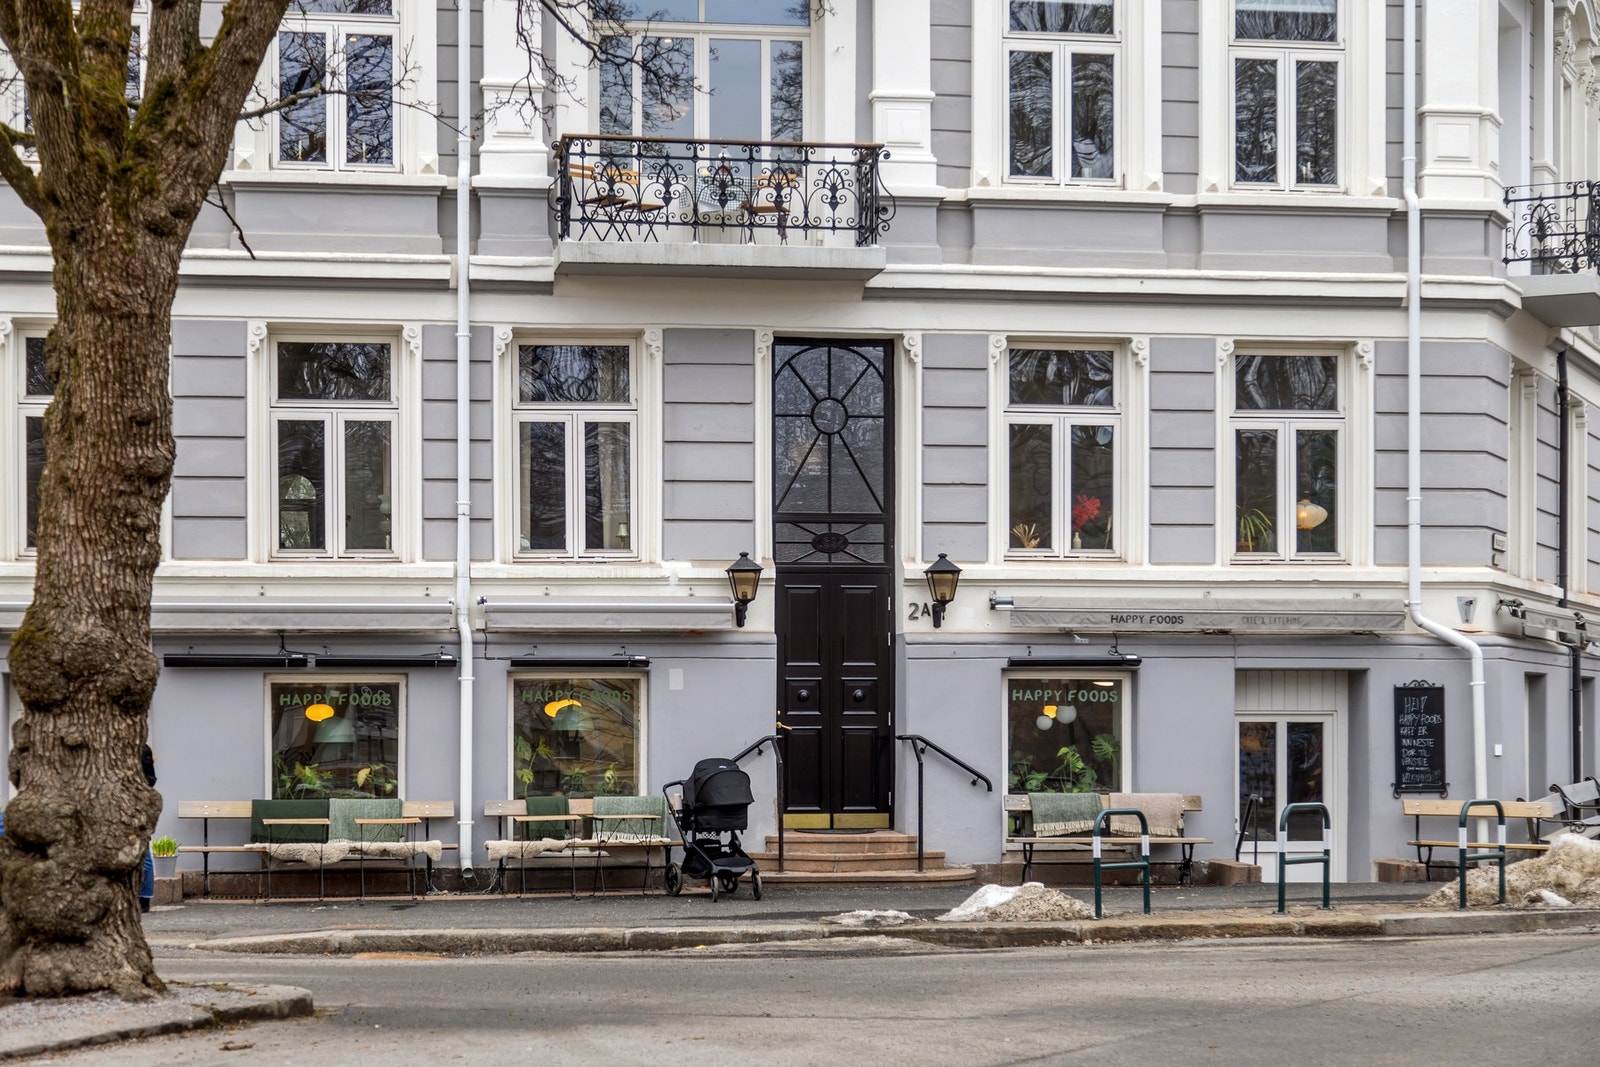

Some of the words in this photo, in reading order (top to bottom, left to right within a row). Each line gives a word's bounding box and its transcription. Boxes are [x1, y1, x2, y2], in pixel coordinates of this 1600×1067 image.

[908, 602, 931, 621] 2A
[1110, 614, 1145, 624] HAPPY
[1149, 615, 1184, 625] FOODS
[279, 693, 332, 706] HAPPY
[338, 693, 391, 706] FOODS
[522, 689, 574, 702] HAPPY
[580, 690, 631, 702] FOODS
[1012, 689, 1062, 702] HAPPY
[1068, 690, 1118, 703] FOODS
[1399, 714, 1420, 726] HAPPY
